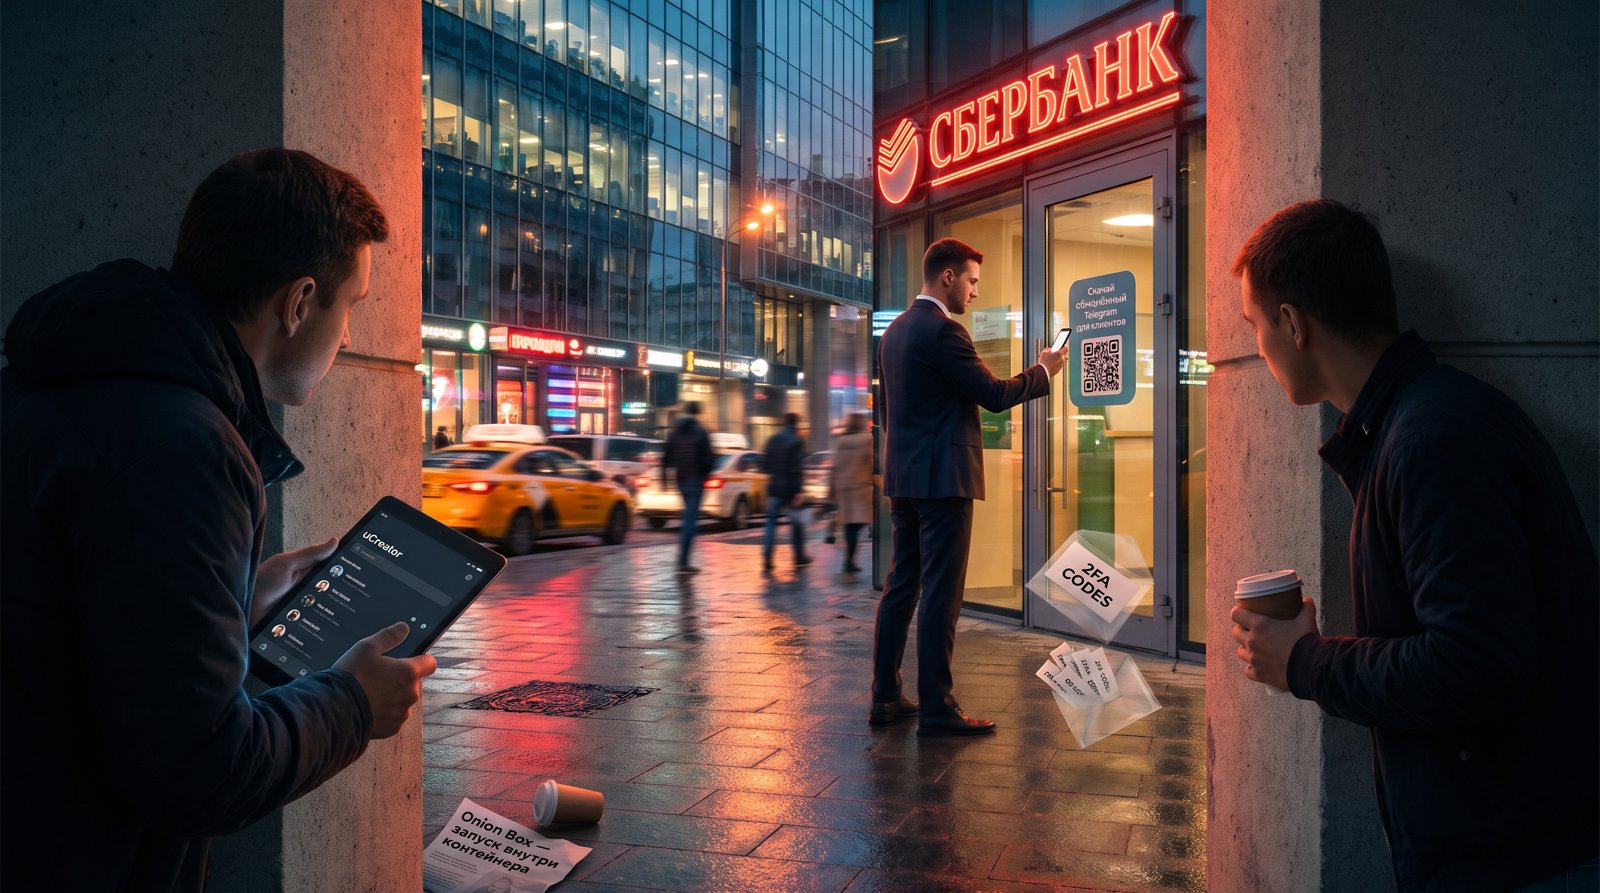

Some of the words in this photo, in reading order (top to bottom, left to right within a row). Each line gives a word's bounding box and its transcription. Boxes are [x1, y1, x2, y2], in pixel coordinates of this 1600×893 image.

[930, 11, 1179, 168] СБЕРБАНК
[1088, 284, 1115, 296] Скачай
[1091, 318, 1126, 329] клиентов
[362, 531, 403, 558] uCreator
[1062, 568, 1113, 608] CODES
[1082, 563, 1110, 588] 2FA
[462, 811, 502, 835] Onion
[504, 829, 533, 847] Box
[442, 837, 530, 874] контейнера
[451, 826, 502, 849] запуск
[503, 846, 559, 869] внутри
